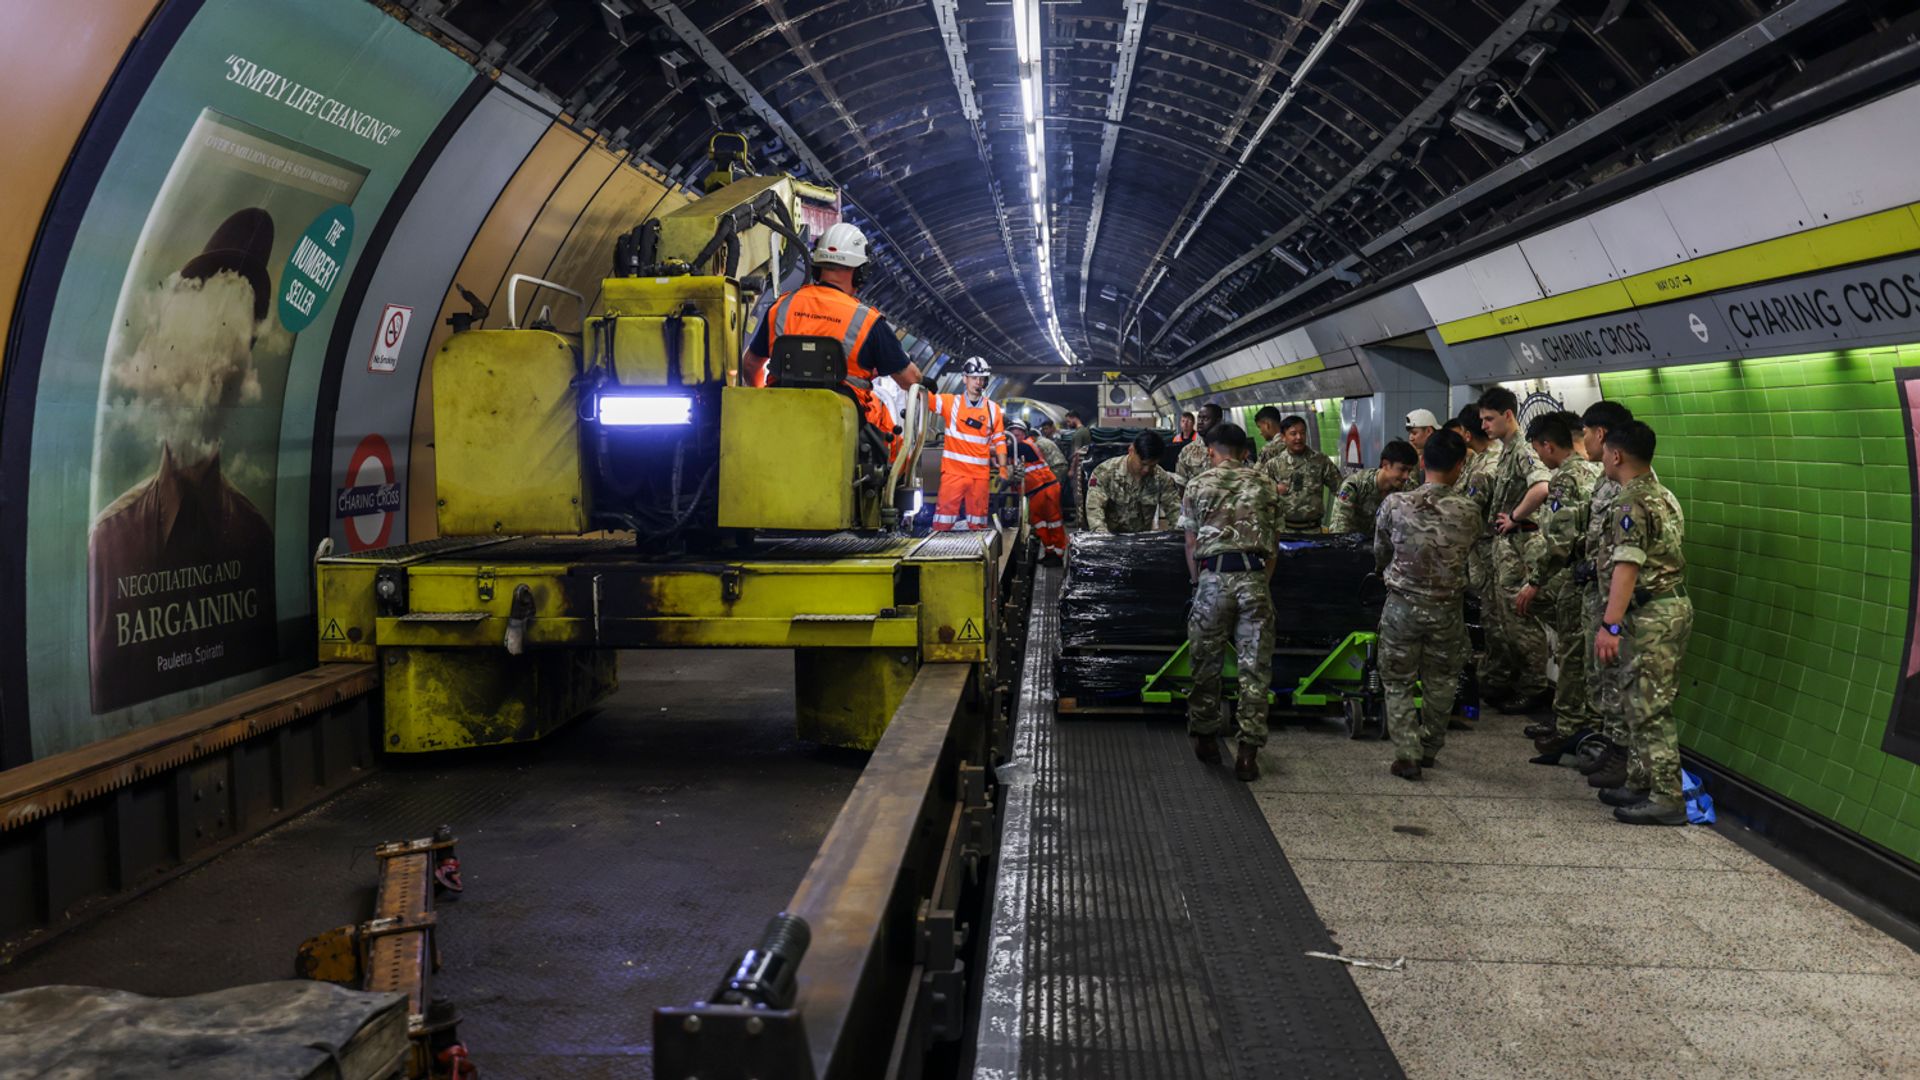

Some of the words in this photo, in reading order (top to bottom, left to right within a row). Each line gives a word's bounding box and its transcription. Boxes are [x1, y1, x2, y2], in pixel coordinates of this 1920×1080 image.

[285, 83, 324, 116] LIFE
[324, 218, 346, 248] THE
[291, 235, 337, 289] NUMBER
[285, 278, 317, 317] SELLER
[1655, 279, 1669, 291] WAY
[1668, 275, 1682, 289] OUT
[1728, 289, 1842, 338] CHARING
[1843, 273, 1920, 323] CROS
[1542, 329, 1602, 362] CHARING
[1600, 322, 1651, 355] CROSS
[379, 354, 397, 367] Smoking
[338, 492, 375, 511] CHARING
[376, 489, 400, 506] CROSS
[117, 564, 213, 599] NEGOTIATING
[214, 560, 241, 582] AND
[115, 588, 257, 647] BARGAINING
[157, 651, 193, 672] Pauletta
[195, 641, 224, 664] Spiratti
